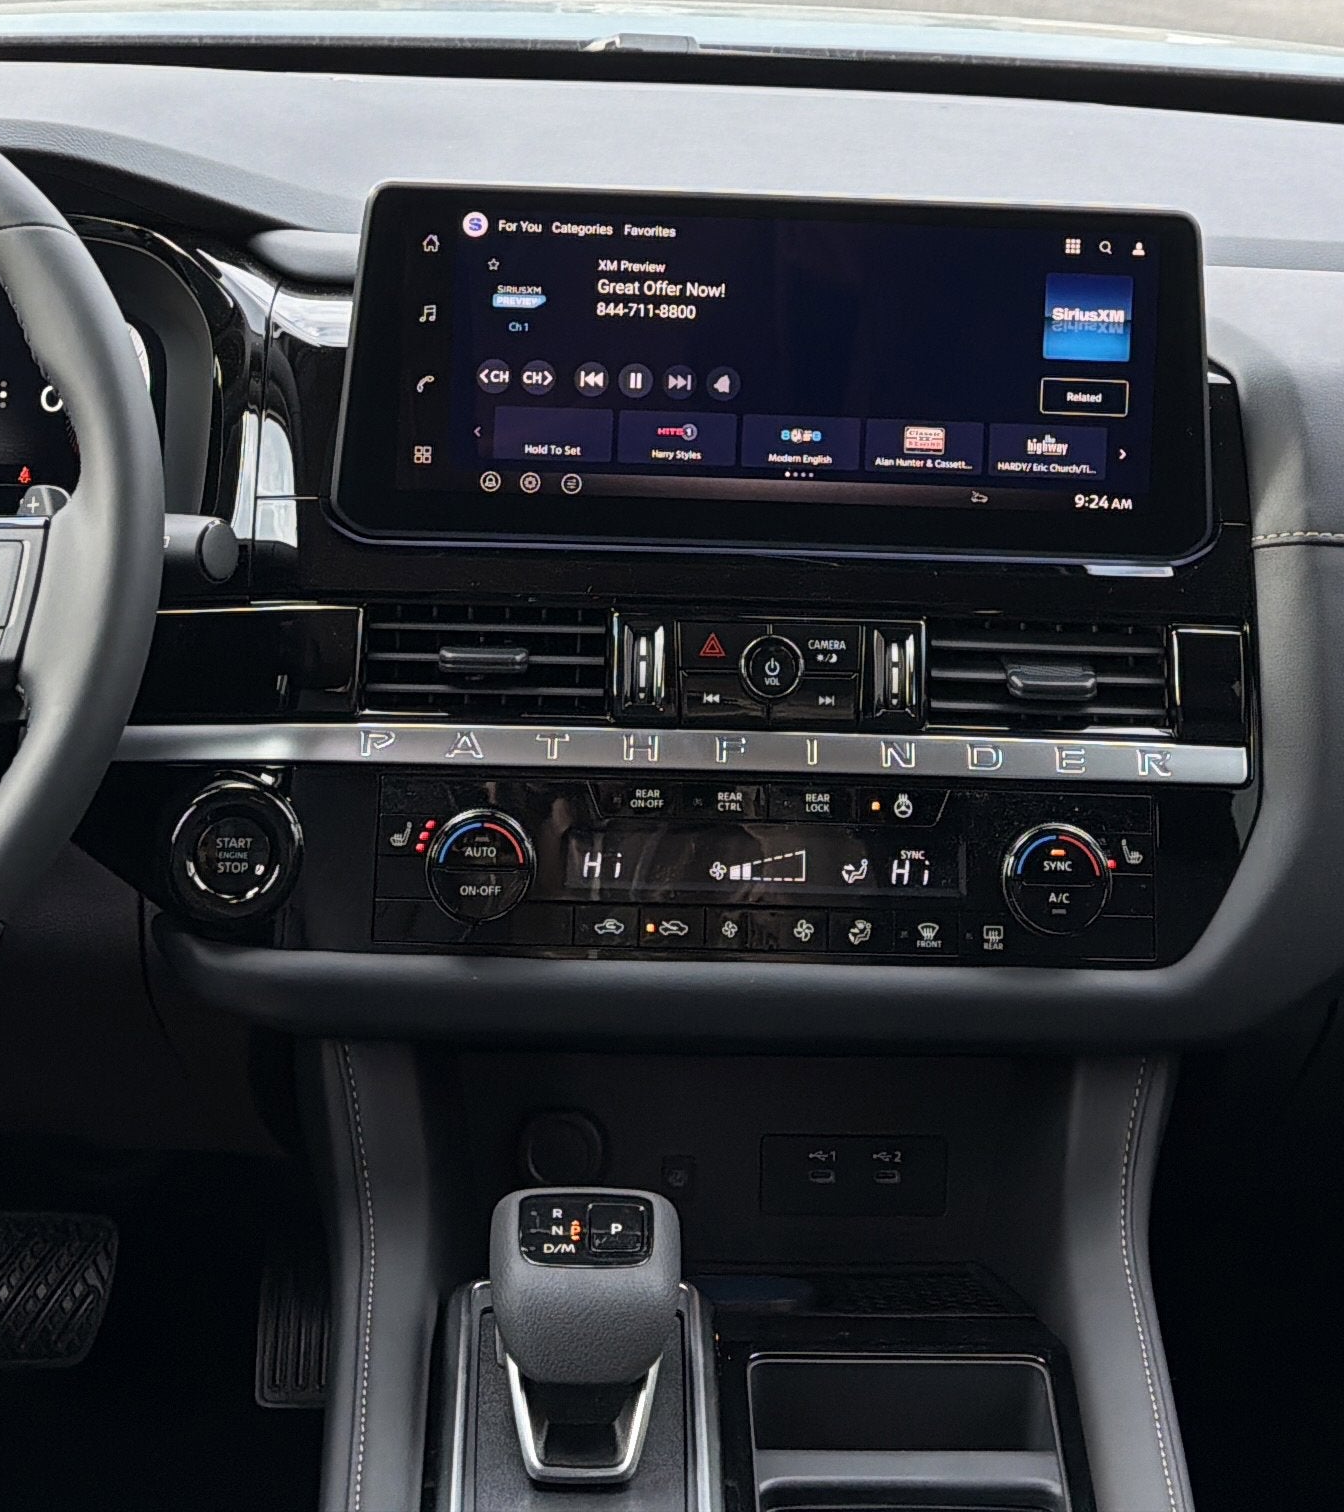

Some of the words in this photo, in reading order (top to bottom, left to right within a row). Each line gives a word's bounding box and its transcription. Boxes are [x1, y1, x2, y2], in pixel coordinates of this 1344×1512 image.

[498, 219, 517, 232] For
[520, 220, 542, 233] You
[551, 222, 613, 237] Categories
[624, 224, 677, 238] Favorites
[598, 259, 618, 272] XM
[620, 260, 666, 274] Preview
[597, 279, 640, 296] Great
[643, 280, 682, 297] Offer
[686, 281, 726, 299] Now!
[596, 302, 697, 320] 844-711-8800
[1051, 307, 1125, 323] SiriusXM
[508, 322, 523, 333] Ch
[1066, 391, 1103, 403] Related
[1044, 434, 1056, 443] the
[524, 443, 548, 455] Hold
[550, 444, 561, 456] To
[564, 445, 581, 457] Set
[1027, 439, 1069, 456] highway
[651, 449, 673, 461] Harry
[676, 450, 702, 462] Styles
[768, 453, 802, 463] Modern
[802, 454, 833, 466] English
[875, 457, 894, 466] Alan
[895, 457, 924, 468] Hunter
[925, 459, 933, 468] &
[997, 462, 1032, 473] HARDY/
[1033, 463, 1048, 472] Eric
[1074, 493, 1109, 509] 9:24
[1111, 498, 1133, 510] AM
[807, 639, 847, 651] CAMERA
[763, 677, 780, 686] VOL
[360, 729, 1172, 777] PATHFINDER
[635, 789, 660, 799] REAR
[717, 792, 743, 803] REAR
[805, 793, 830, 804] REAR
[717, 801, 742, 812] CTRL
[805, 802, 830, 813] LOCK
[215, 837, 253, 849] START
[218, 851, 248, 859] ENGINE
[464, 846, 497, 858] AUTO
[900, 850, 925, 860] SYNC
[217, 861, 249, 874] STOP
[582, 852, 623, 879] Hi
[1043, 860, 1073, 872] SYNC
[890, 859, 931, 886] Hi
[1048, 892, 1071, 905] A/C
[916, 939, 942, 949] FRONT
[983, 941, 1004, 951] REAR
[894, 1151, 902, 1163] 2
[552, 1208, 563, 1219] R
[551, 1225, 564, 1236] N
[610, 1223, 622, 1235] P
[543, 1243, 576, 1254] D/M
